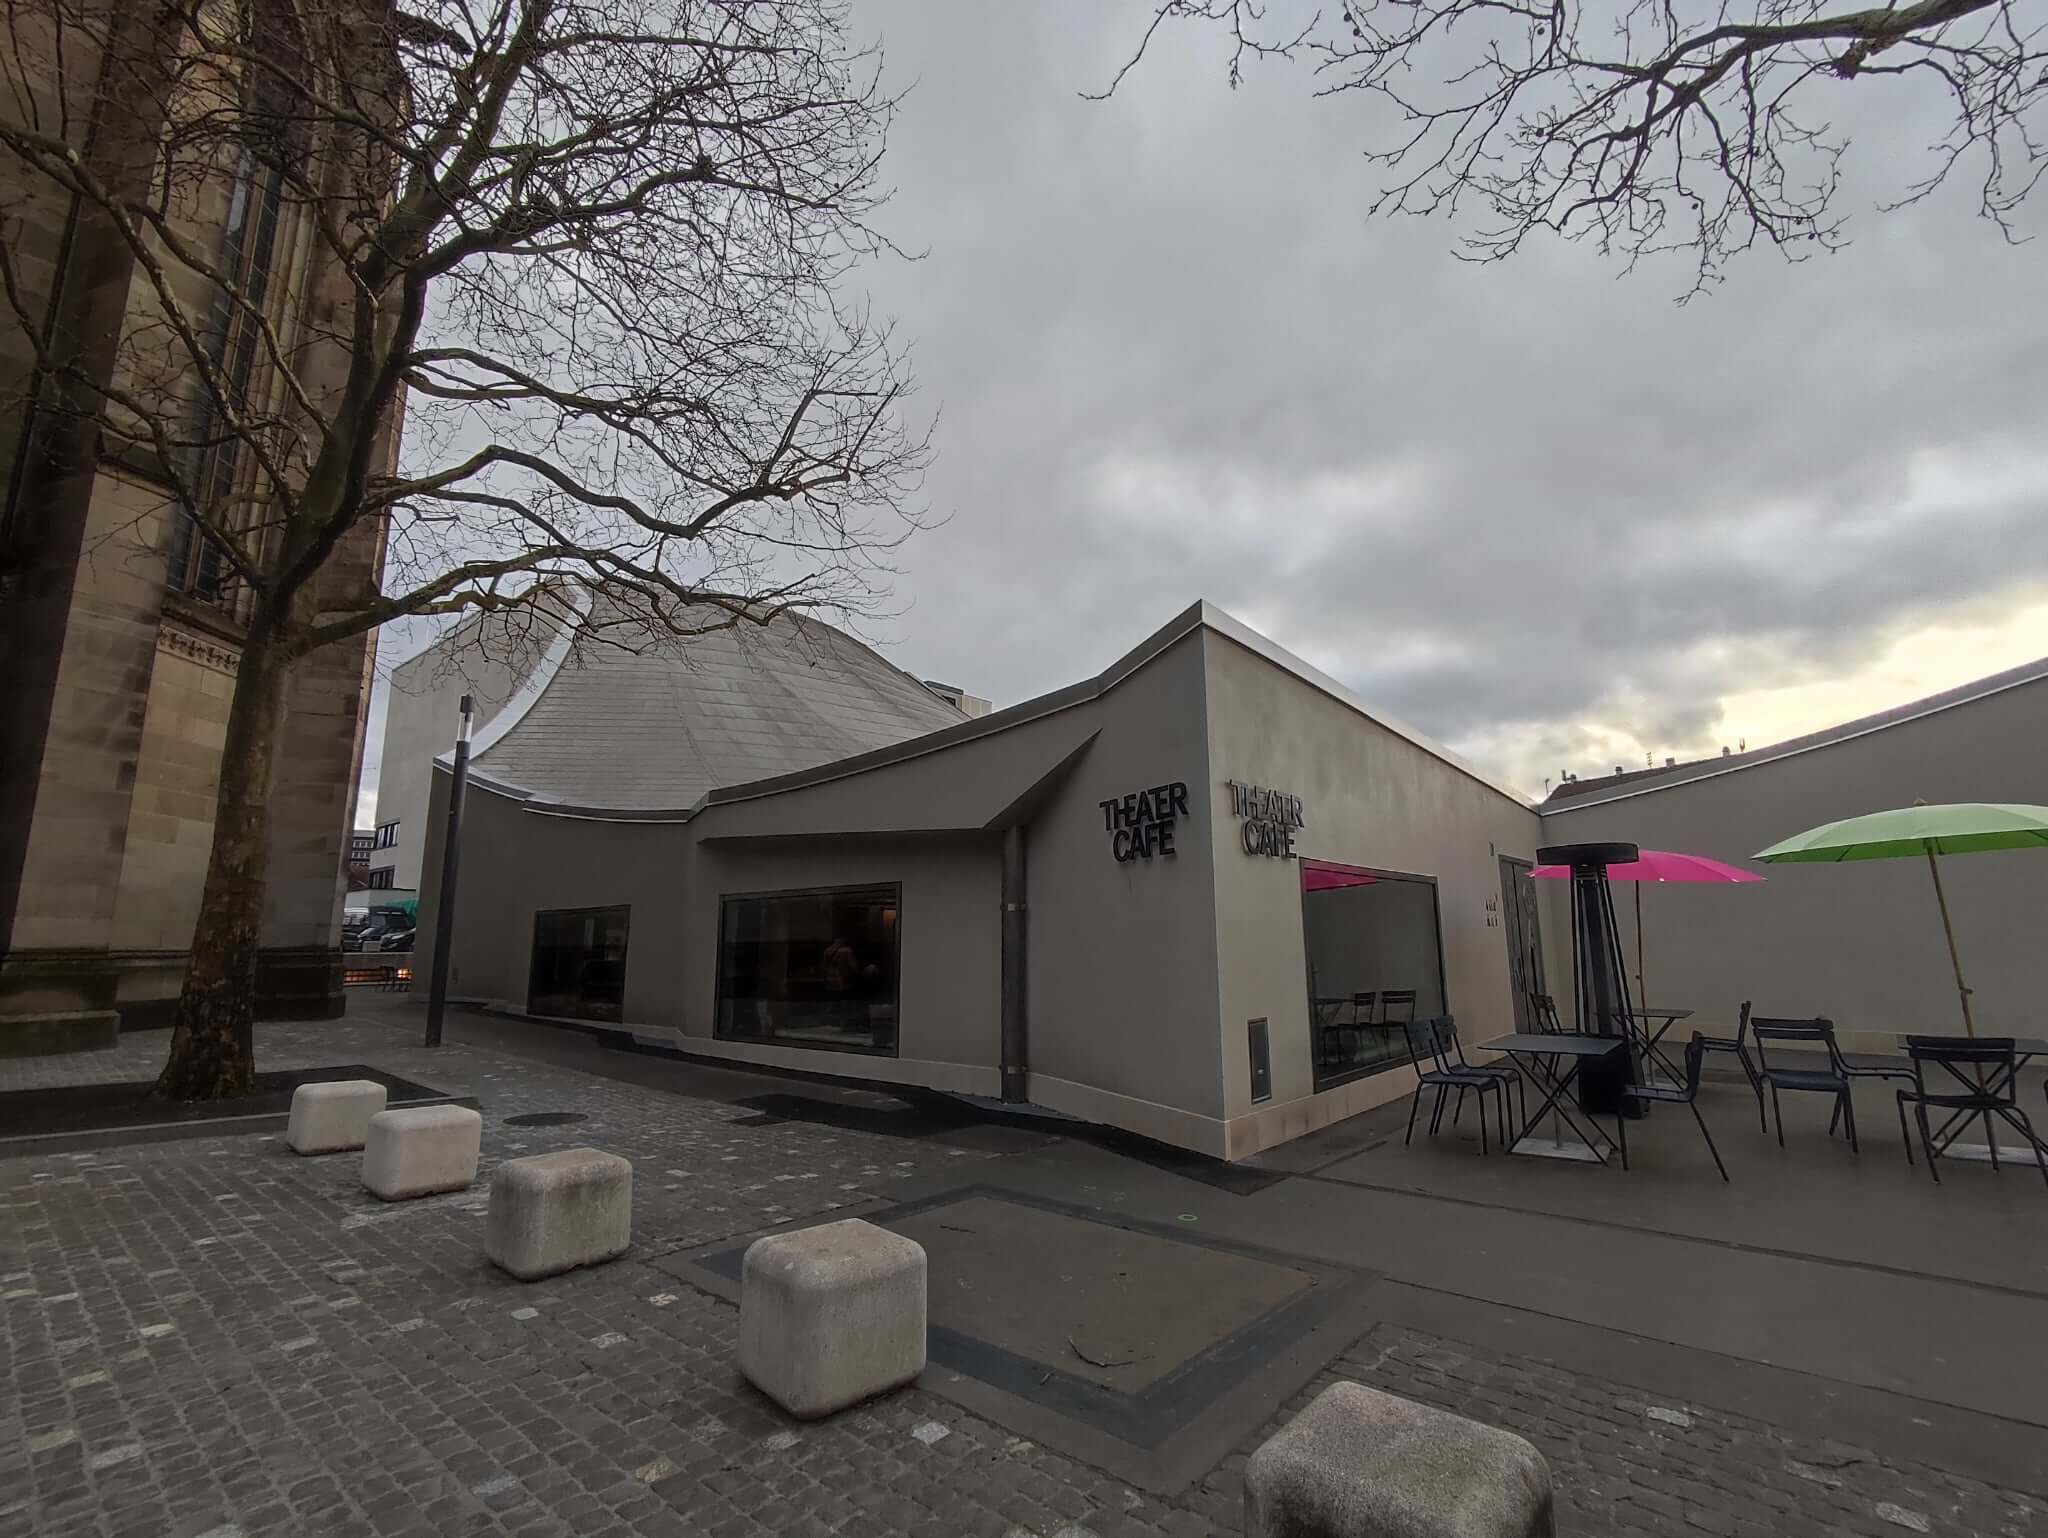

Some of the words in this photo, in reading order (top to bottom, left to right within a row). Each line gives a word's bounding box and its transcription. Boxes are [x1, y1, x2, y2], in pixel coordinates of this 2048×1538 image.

[1099, 782, 1188, 831] THEATER
[1227, 779, 1304, 828] THEATER
[1113, 820, 1175, 862] CAFE
[1242, 820, 1297, 859] CAFE
